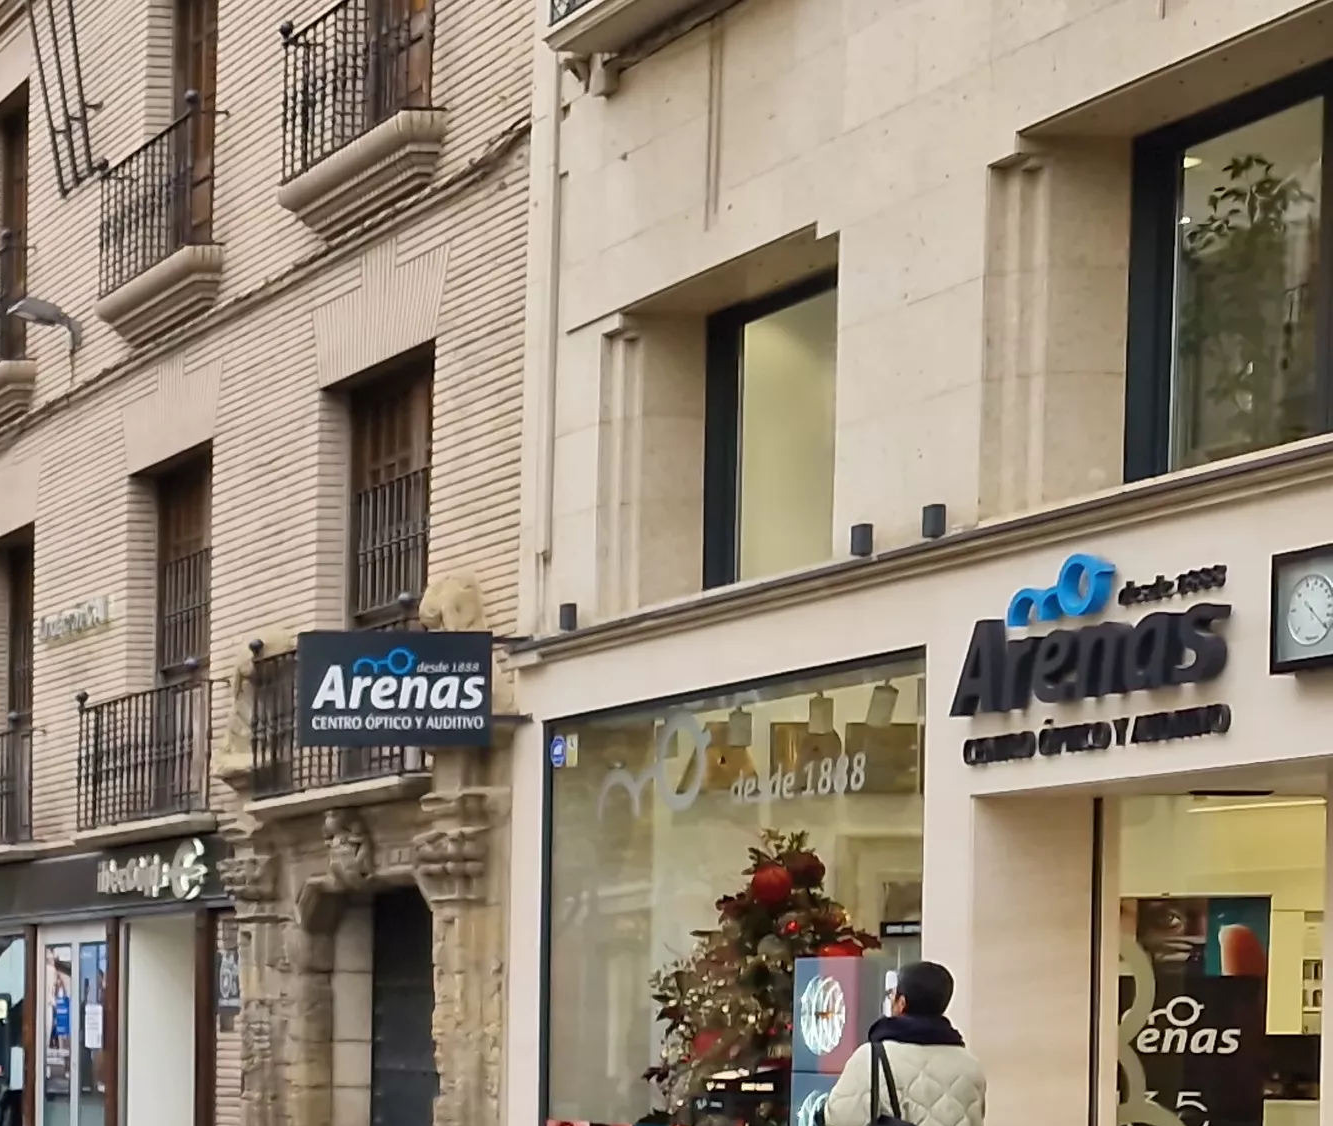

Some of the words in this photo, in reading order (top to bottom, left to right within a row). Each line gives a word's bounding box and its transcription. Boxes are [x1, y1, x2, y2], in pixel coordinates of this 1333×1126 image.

[416, 661, 449, 673] desde
[949, 602, 1232, 717] Arenas
[311, 664, 485, 710] Arenas
[311, 715, 362, 730] CENTRO
[365, 713, 412, 730] ÓPTICO
[416, 716, 426, 730] Y
[426, 715, 484, 730] AUDITIVO
[731, 763, 796, 801] dede
[802, 751, 867, 796] 1888
[1136, 1027, 1242, 1055] enas
